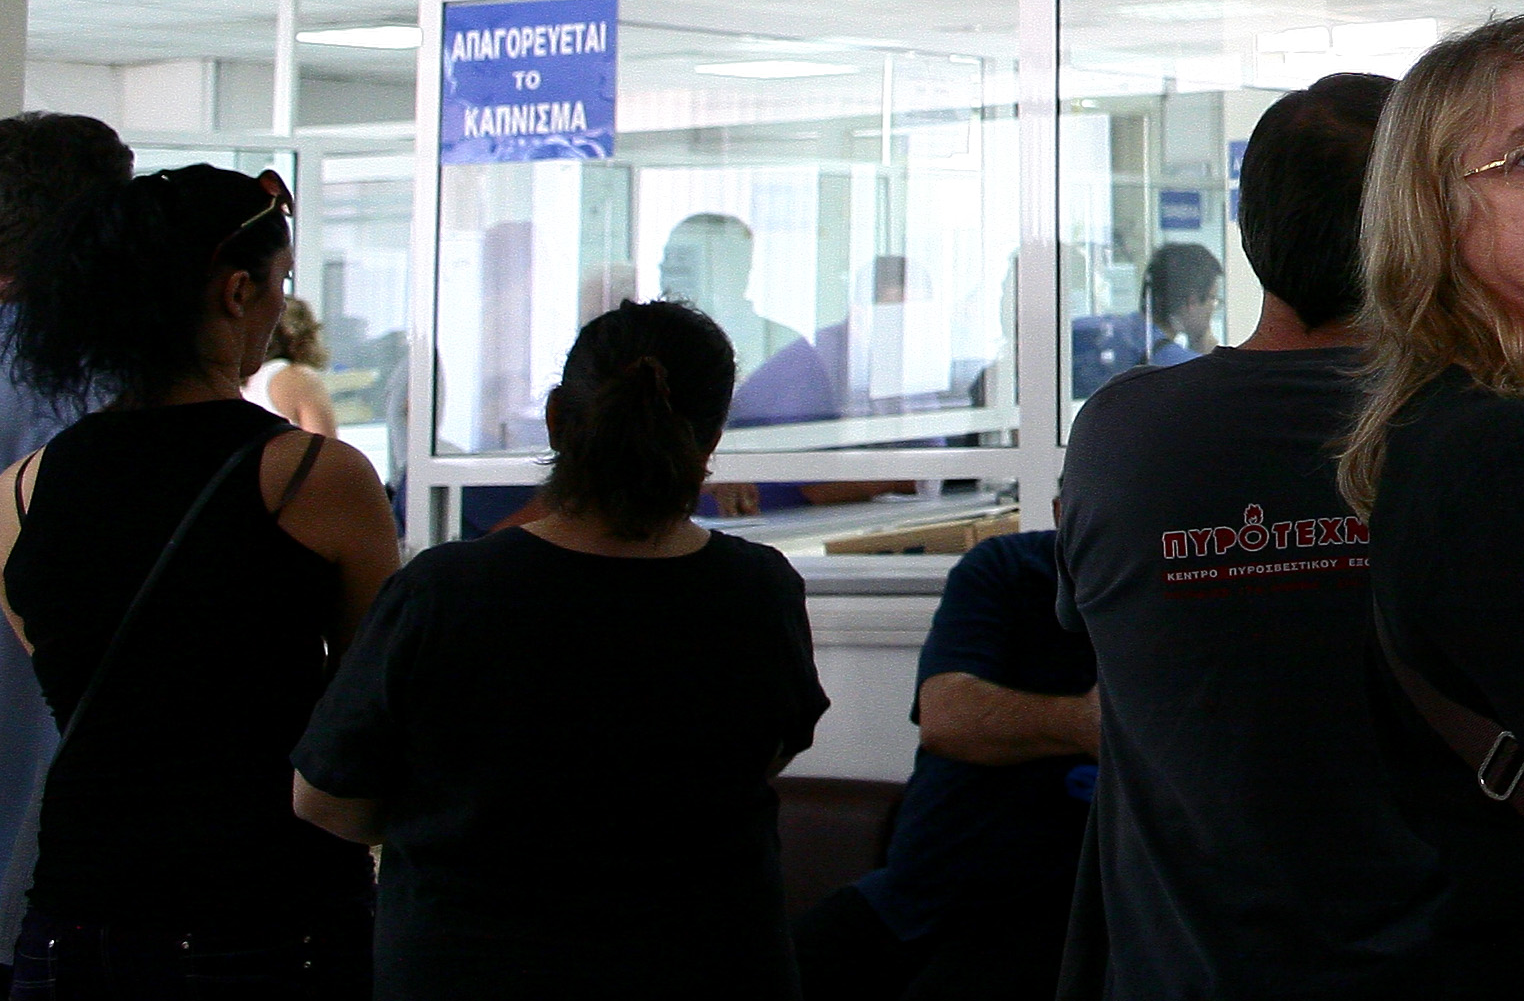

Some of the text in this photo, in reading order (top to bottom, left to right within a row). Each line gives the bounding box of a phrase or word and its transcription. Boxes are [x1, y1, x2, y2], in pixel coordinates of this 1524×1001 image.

[451, 20, 607, 63] ΑΠΑΓΟΡΕΥΕΤΑΙ
[511, 69, 542, 91] ΤΟ
[464, 100, 588, 138] ΚΑΠΝΙΣΜΑ
[1167, 569, 1218, 582] ΚΕΝΤΡΟ
[1228, 559, 1338, 577] ΠΥΡΟΣΒΕΣΤΙΚΟΥ
